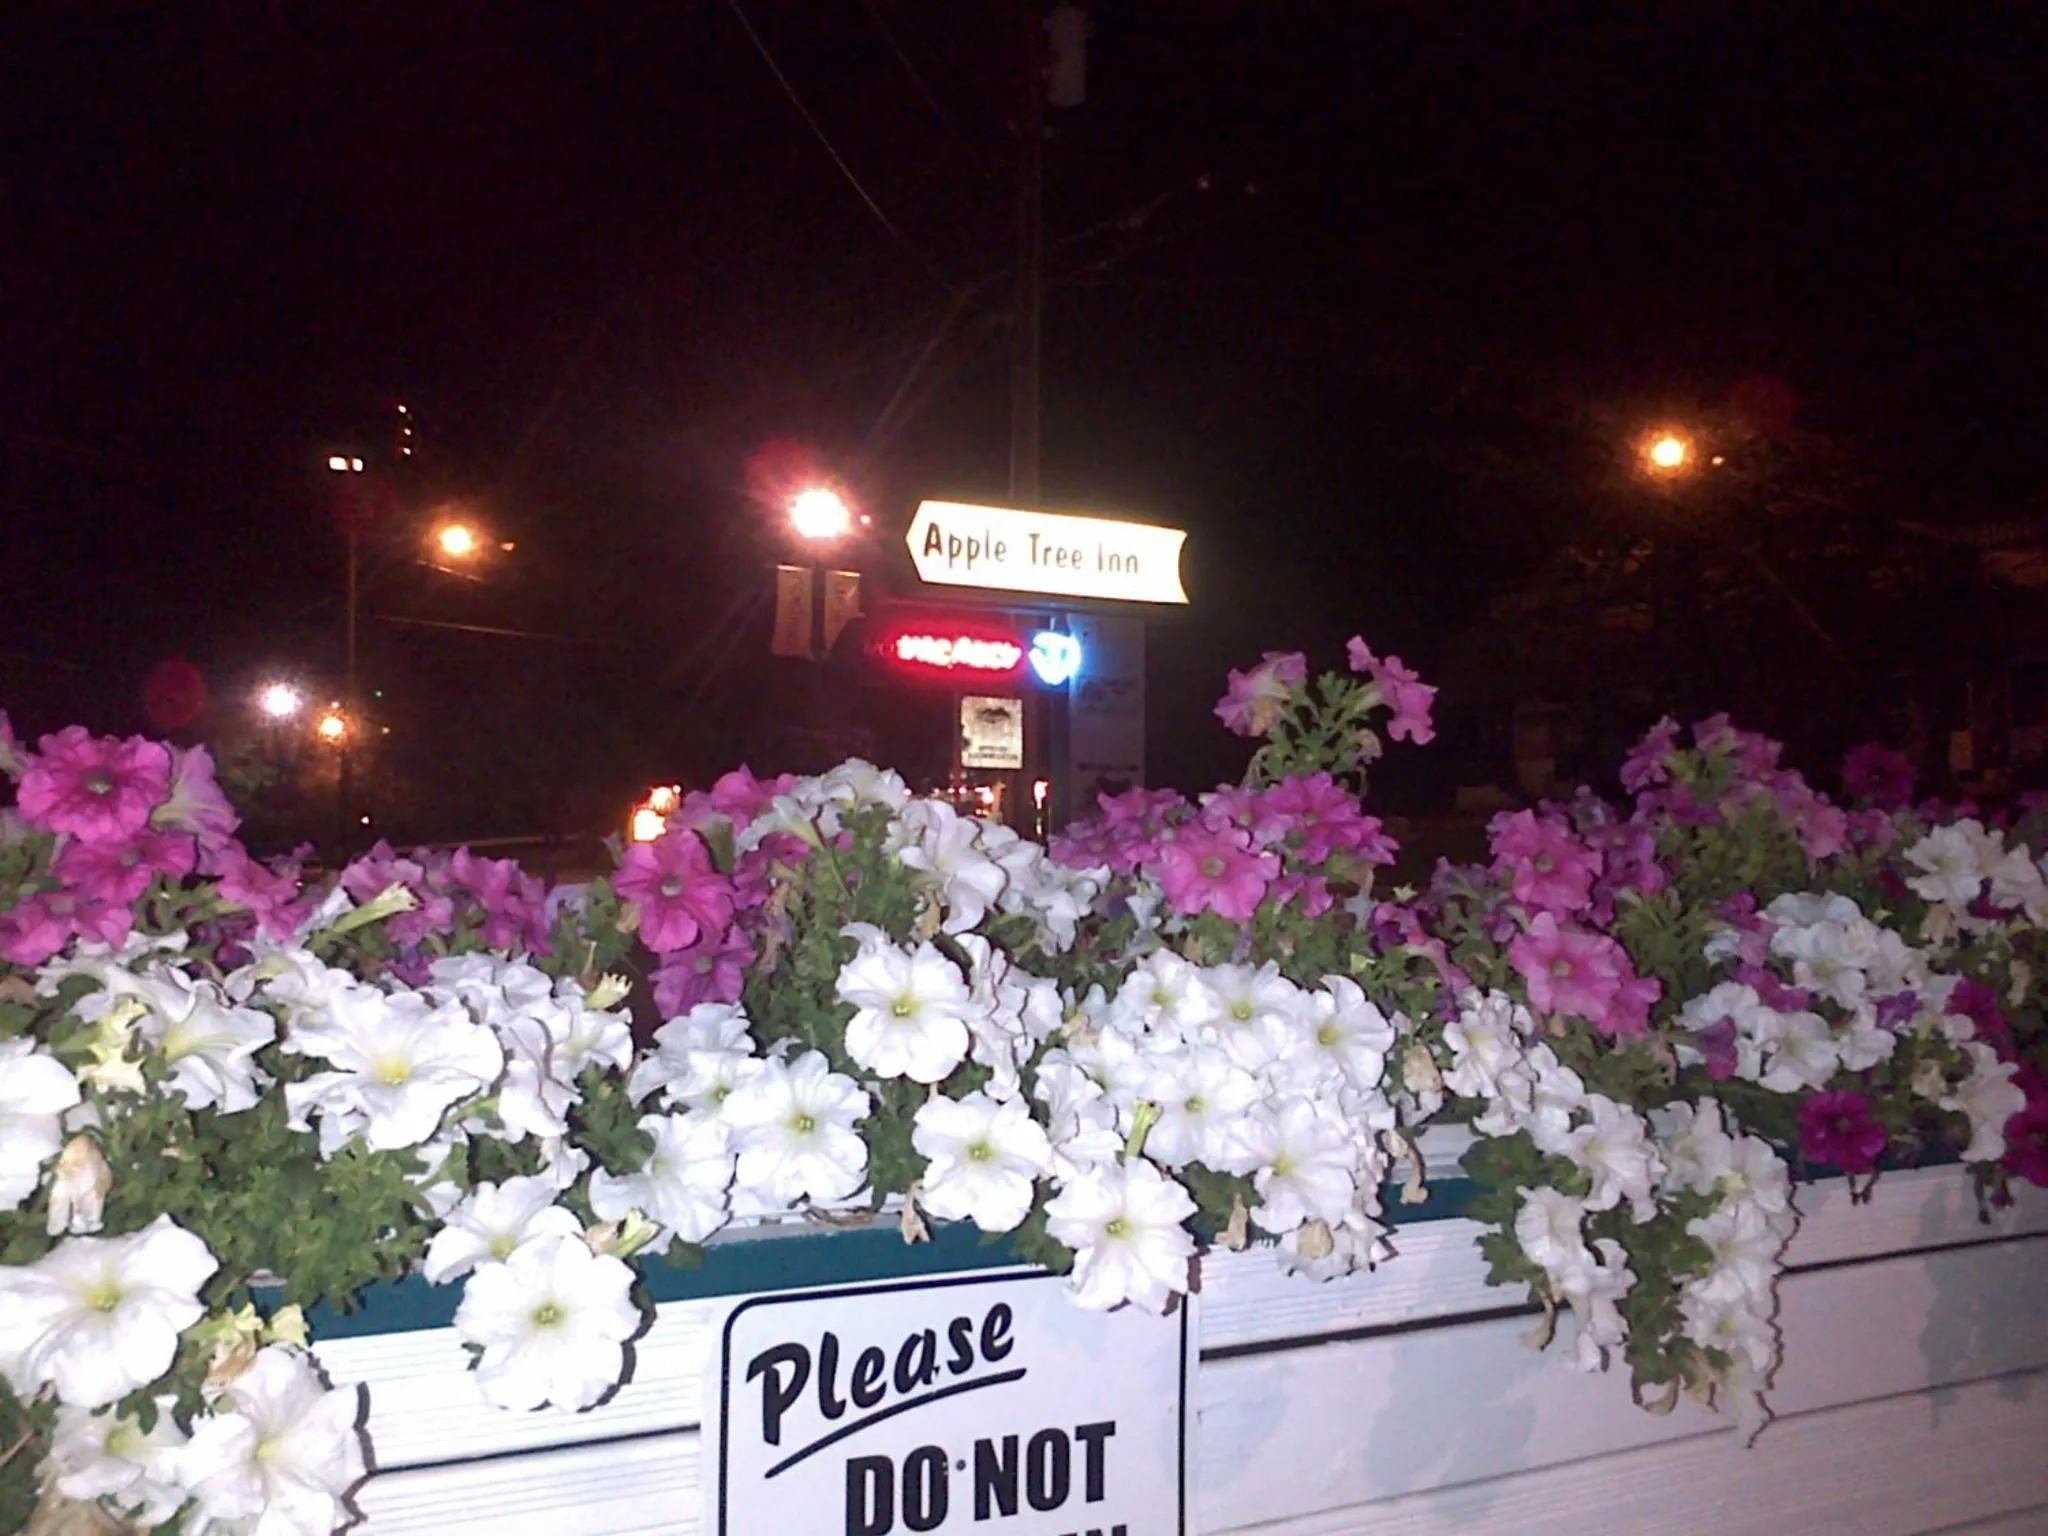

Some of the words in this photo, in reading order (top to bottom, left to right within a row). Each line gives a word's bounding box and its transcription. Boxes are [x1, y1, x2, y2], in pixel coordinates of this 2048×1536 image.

[922, 521, 1007, 571] Apple
[1028, 533, 1084, 570] Tree
[745, 1302, 1015, 1446] Please
[845, 1444, 949, 1536] DO
[974, 1420, 1116, 1522] NOT
